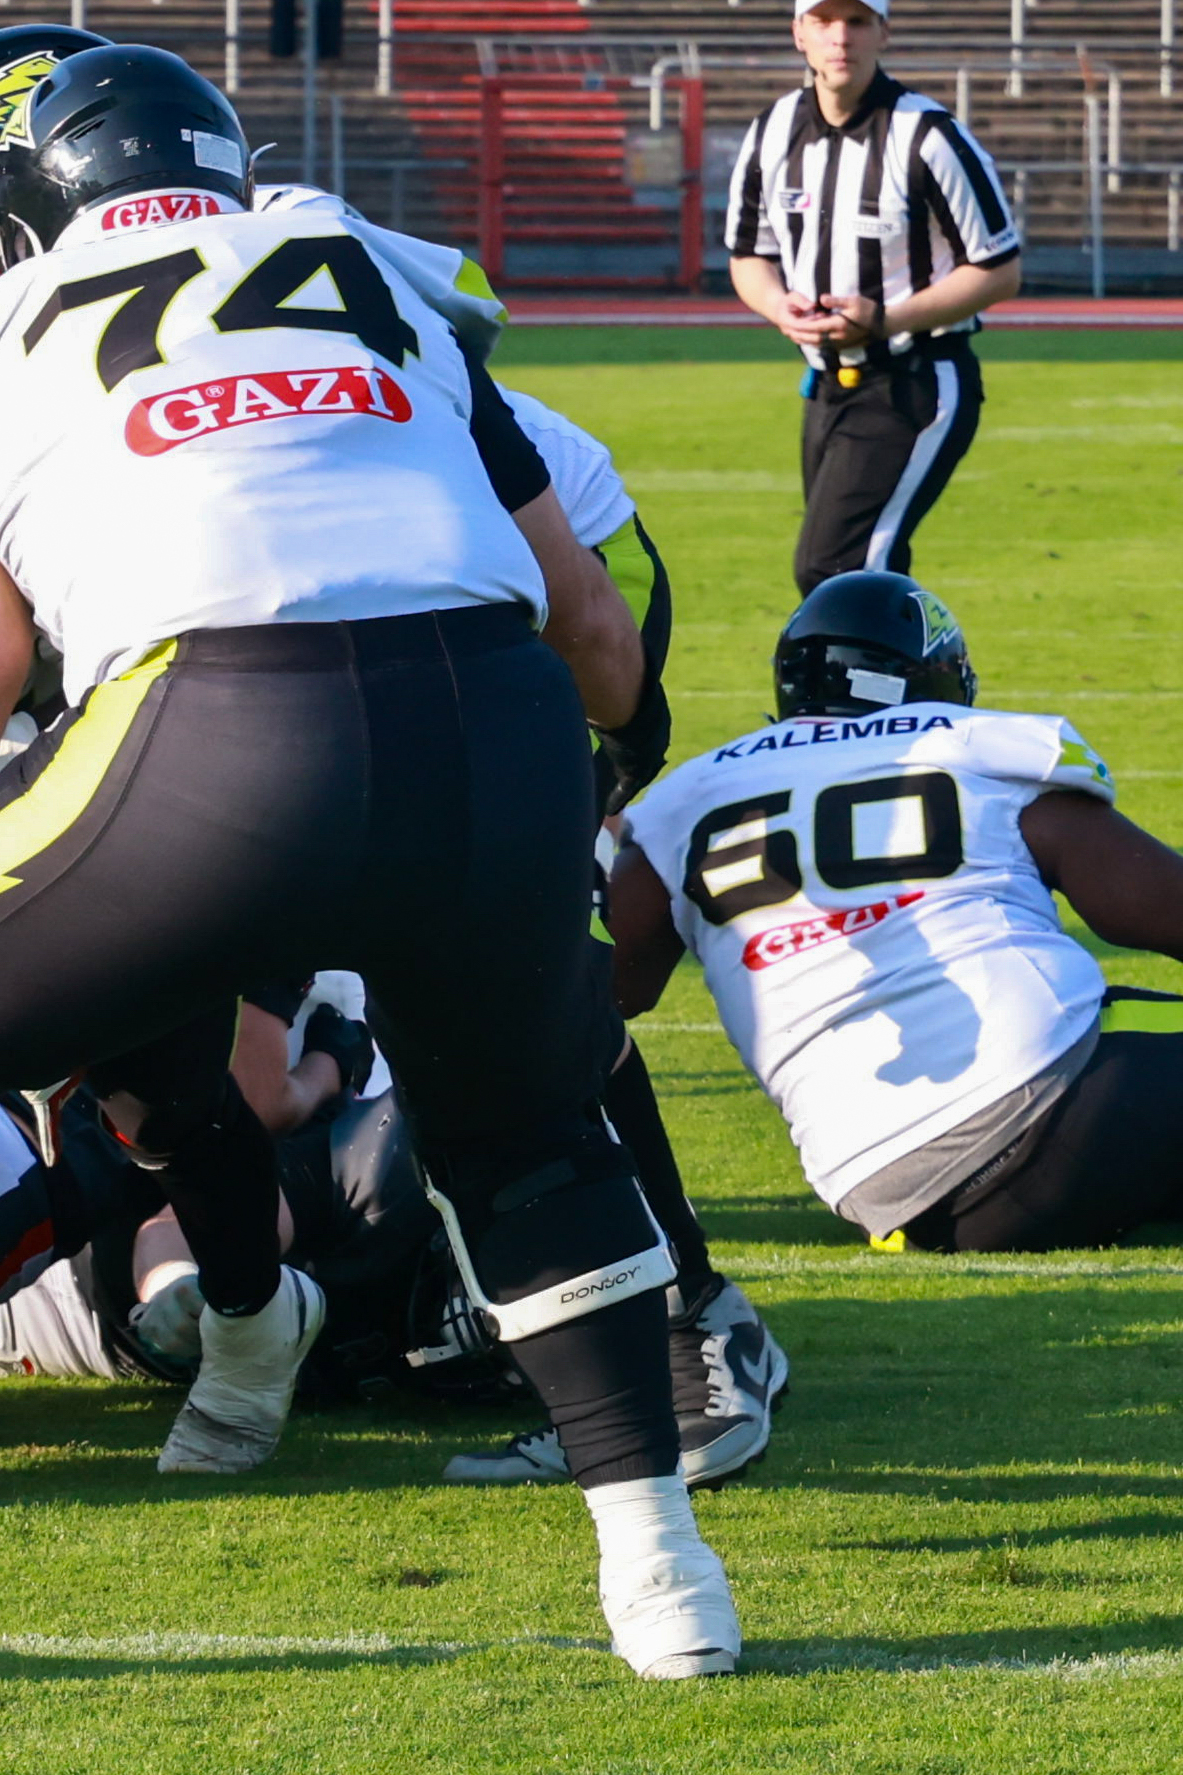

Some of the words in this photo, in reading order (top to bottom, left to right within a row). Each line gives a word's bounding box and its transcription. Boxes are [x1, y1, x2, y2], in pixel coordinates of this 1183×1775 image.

[114, 195, 211, 230] GAZI
[22, 233, 420, 394] 74
[147, 369, 395, 441] GAZI
[713, 715, 955, 764] KALEMBA
[682, 770, 966, 928] 60
[560, 1265, 641, 1305] DONJOY
